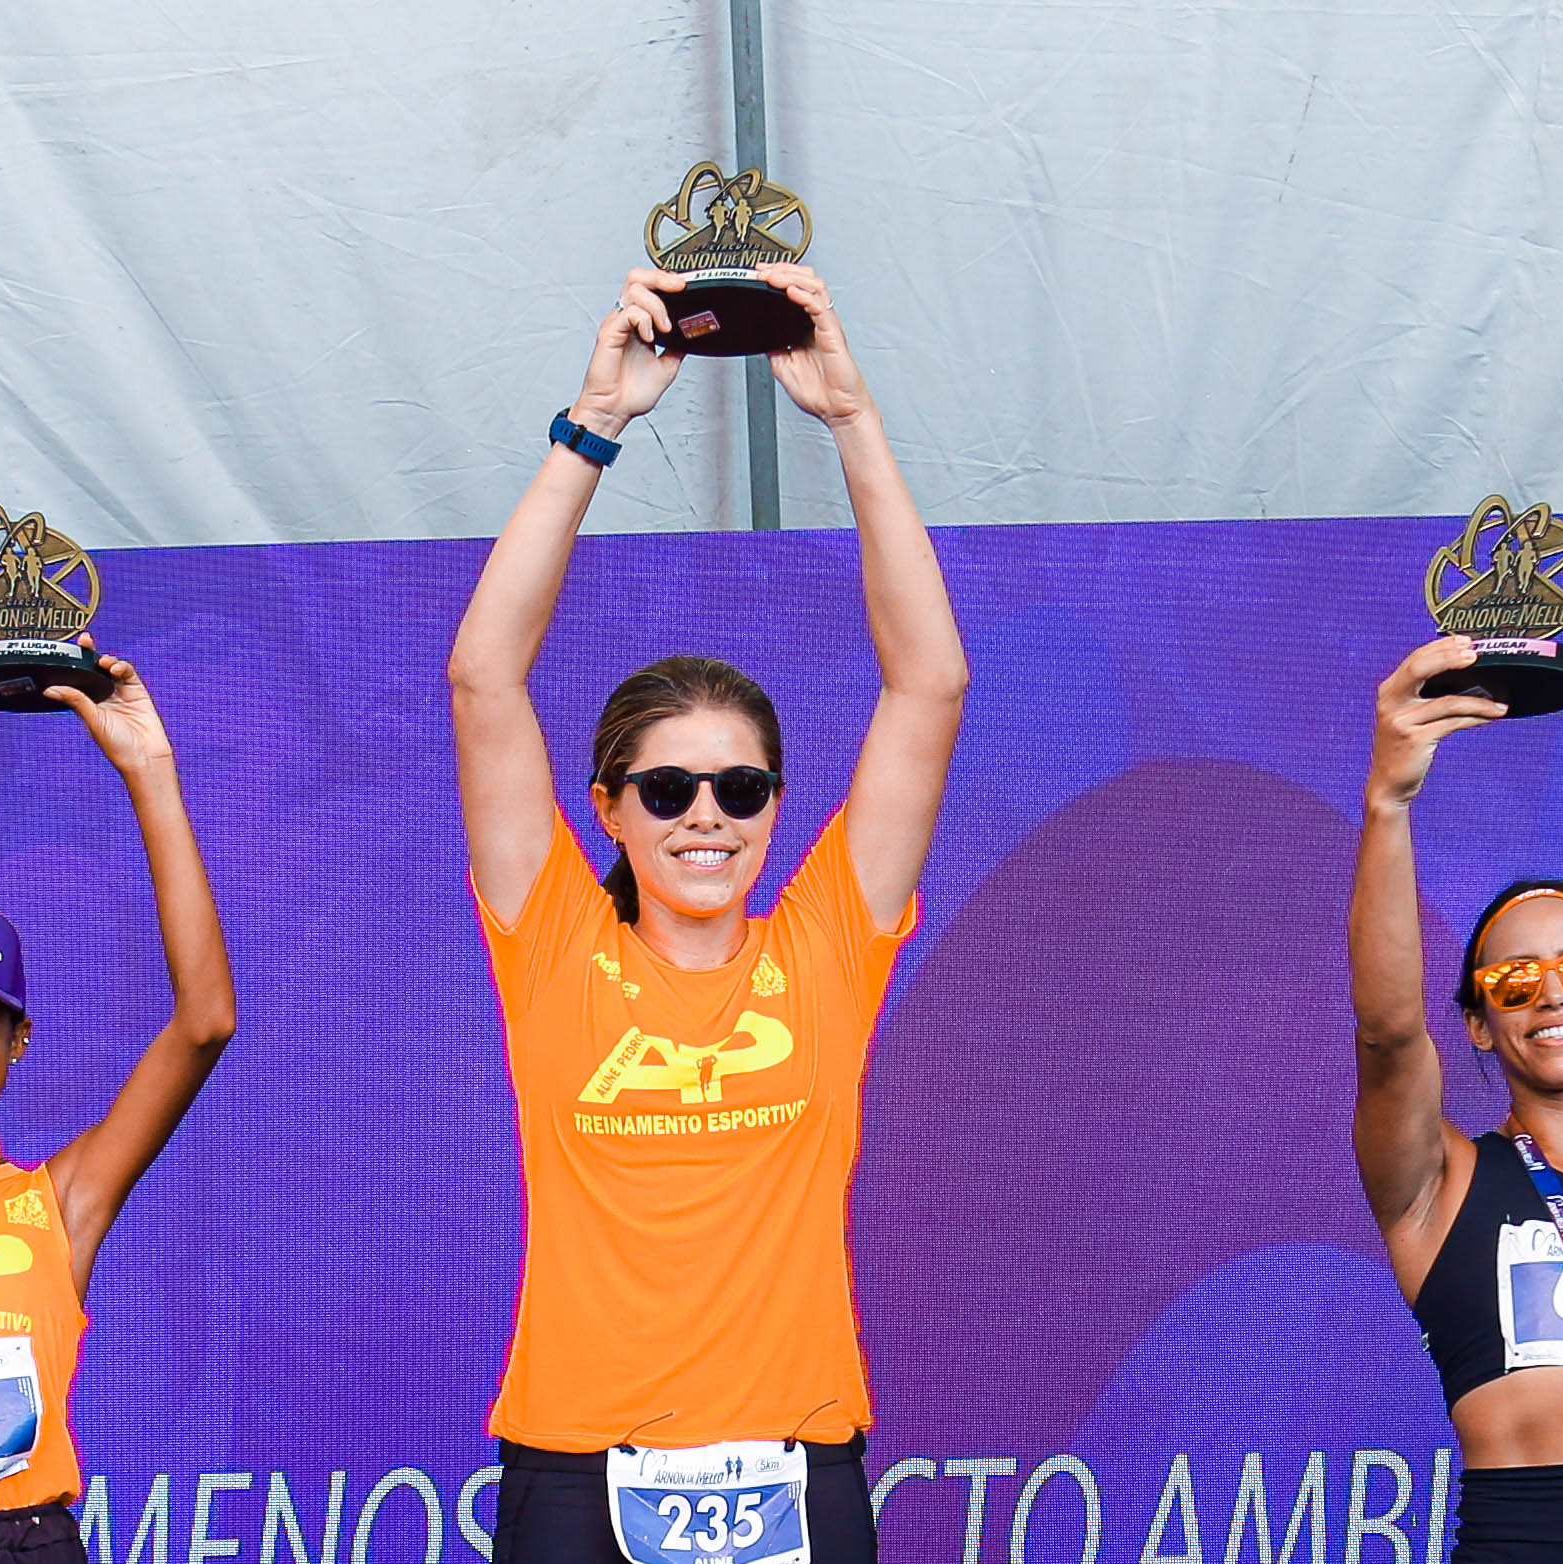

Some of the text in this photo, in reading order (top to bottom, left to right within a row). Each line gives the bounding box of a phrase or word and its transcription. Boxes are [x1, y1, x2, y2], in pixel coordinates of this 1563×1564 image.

[663, 250, 794, 270] ARNON DE MELLO
[708, 270, 747, 279] LUGAR
[22, 610, 36, 626] DE
[37, 607, 85, 629] MELLO
[1439, 607, 1502, 630] ARNON
[1501, 609, 1517, 625] DE
[21, 642, 58, 650] LUGAR
[1486, 641, 1527, 650] LUGAR
[595, 1066, 623, 1099] ALINE
[617, 1033, 647, 1070] PEDRO
[573, 1099, 808, 1137] TREINAMENTO ESPORTIVO
[654, 1469, 685, 1485] ARNON
[695, 1470, 725, 1486] MELLO
[657, 1491, 765, 1553] 235
